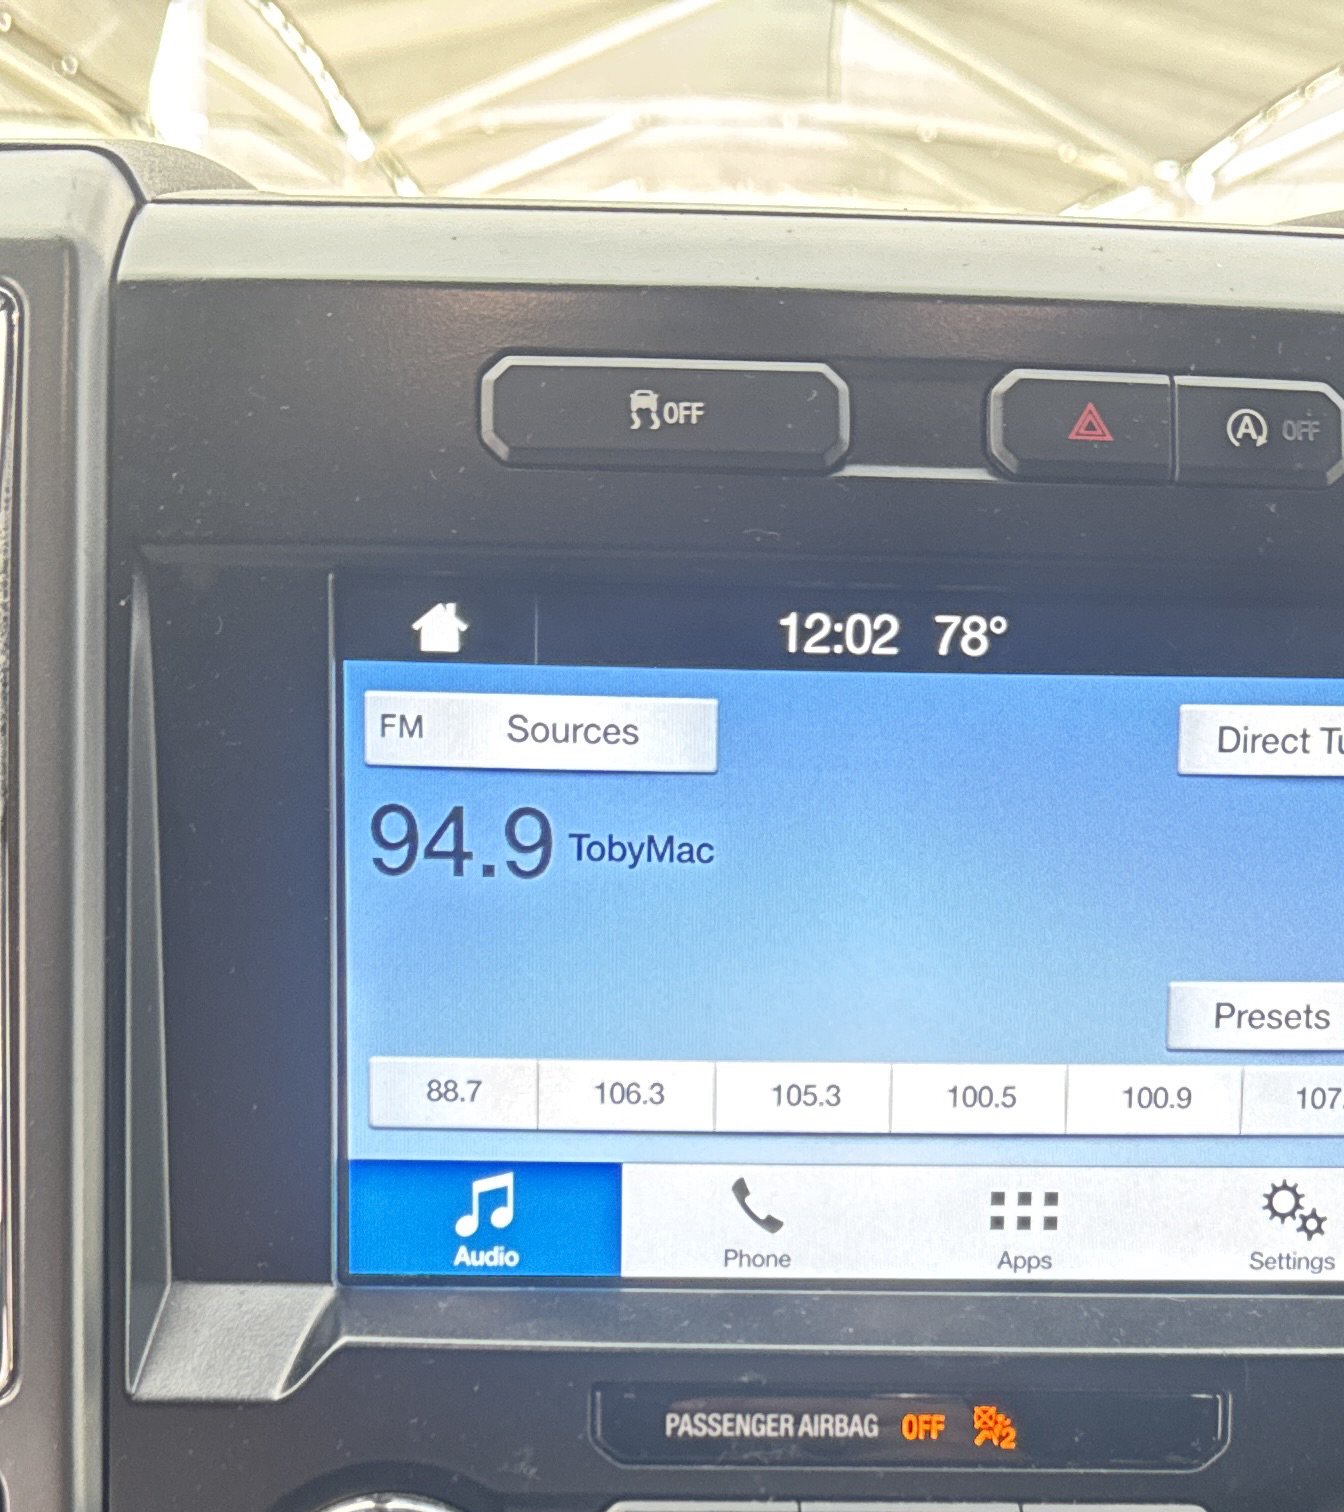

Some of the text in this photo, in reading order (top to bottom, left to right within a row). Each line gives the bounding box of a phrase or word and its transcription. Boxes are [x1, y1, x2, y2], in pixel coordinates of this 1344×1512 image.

[663, 400, 704, 425] OFF
[1282, 418, 1320, 442] OFF
[779, 611, 900, 655] 12:02
[379, 714, 640, 747] FM Sources
[1217, 726, 1311, 755] Direct
[370, 803, 715, 880] 94.9 TobyMac
[1214, 1002, 1331, 1031] Presets
[425, 1079, 483, 1103] 88.7
[594, 1082, 666, 1107] 106.3
[771, 1084, 842, 1108] 105.3
[947, 1085, 1017, 1109] 100.5
[1122, 1086, 1193, 1110] 100.9
[453, 1245, 520, 1268] Audio
[723, 1248, 792, 1269] Phone
[997, 1251, 1053, 1275] Apps
[1249, 1251, 1336, 1275] Settings
[665, 1412, 946, 1441] PASSENGER AIRBAG OFF
